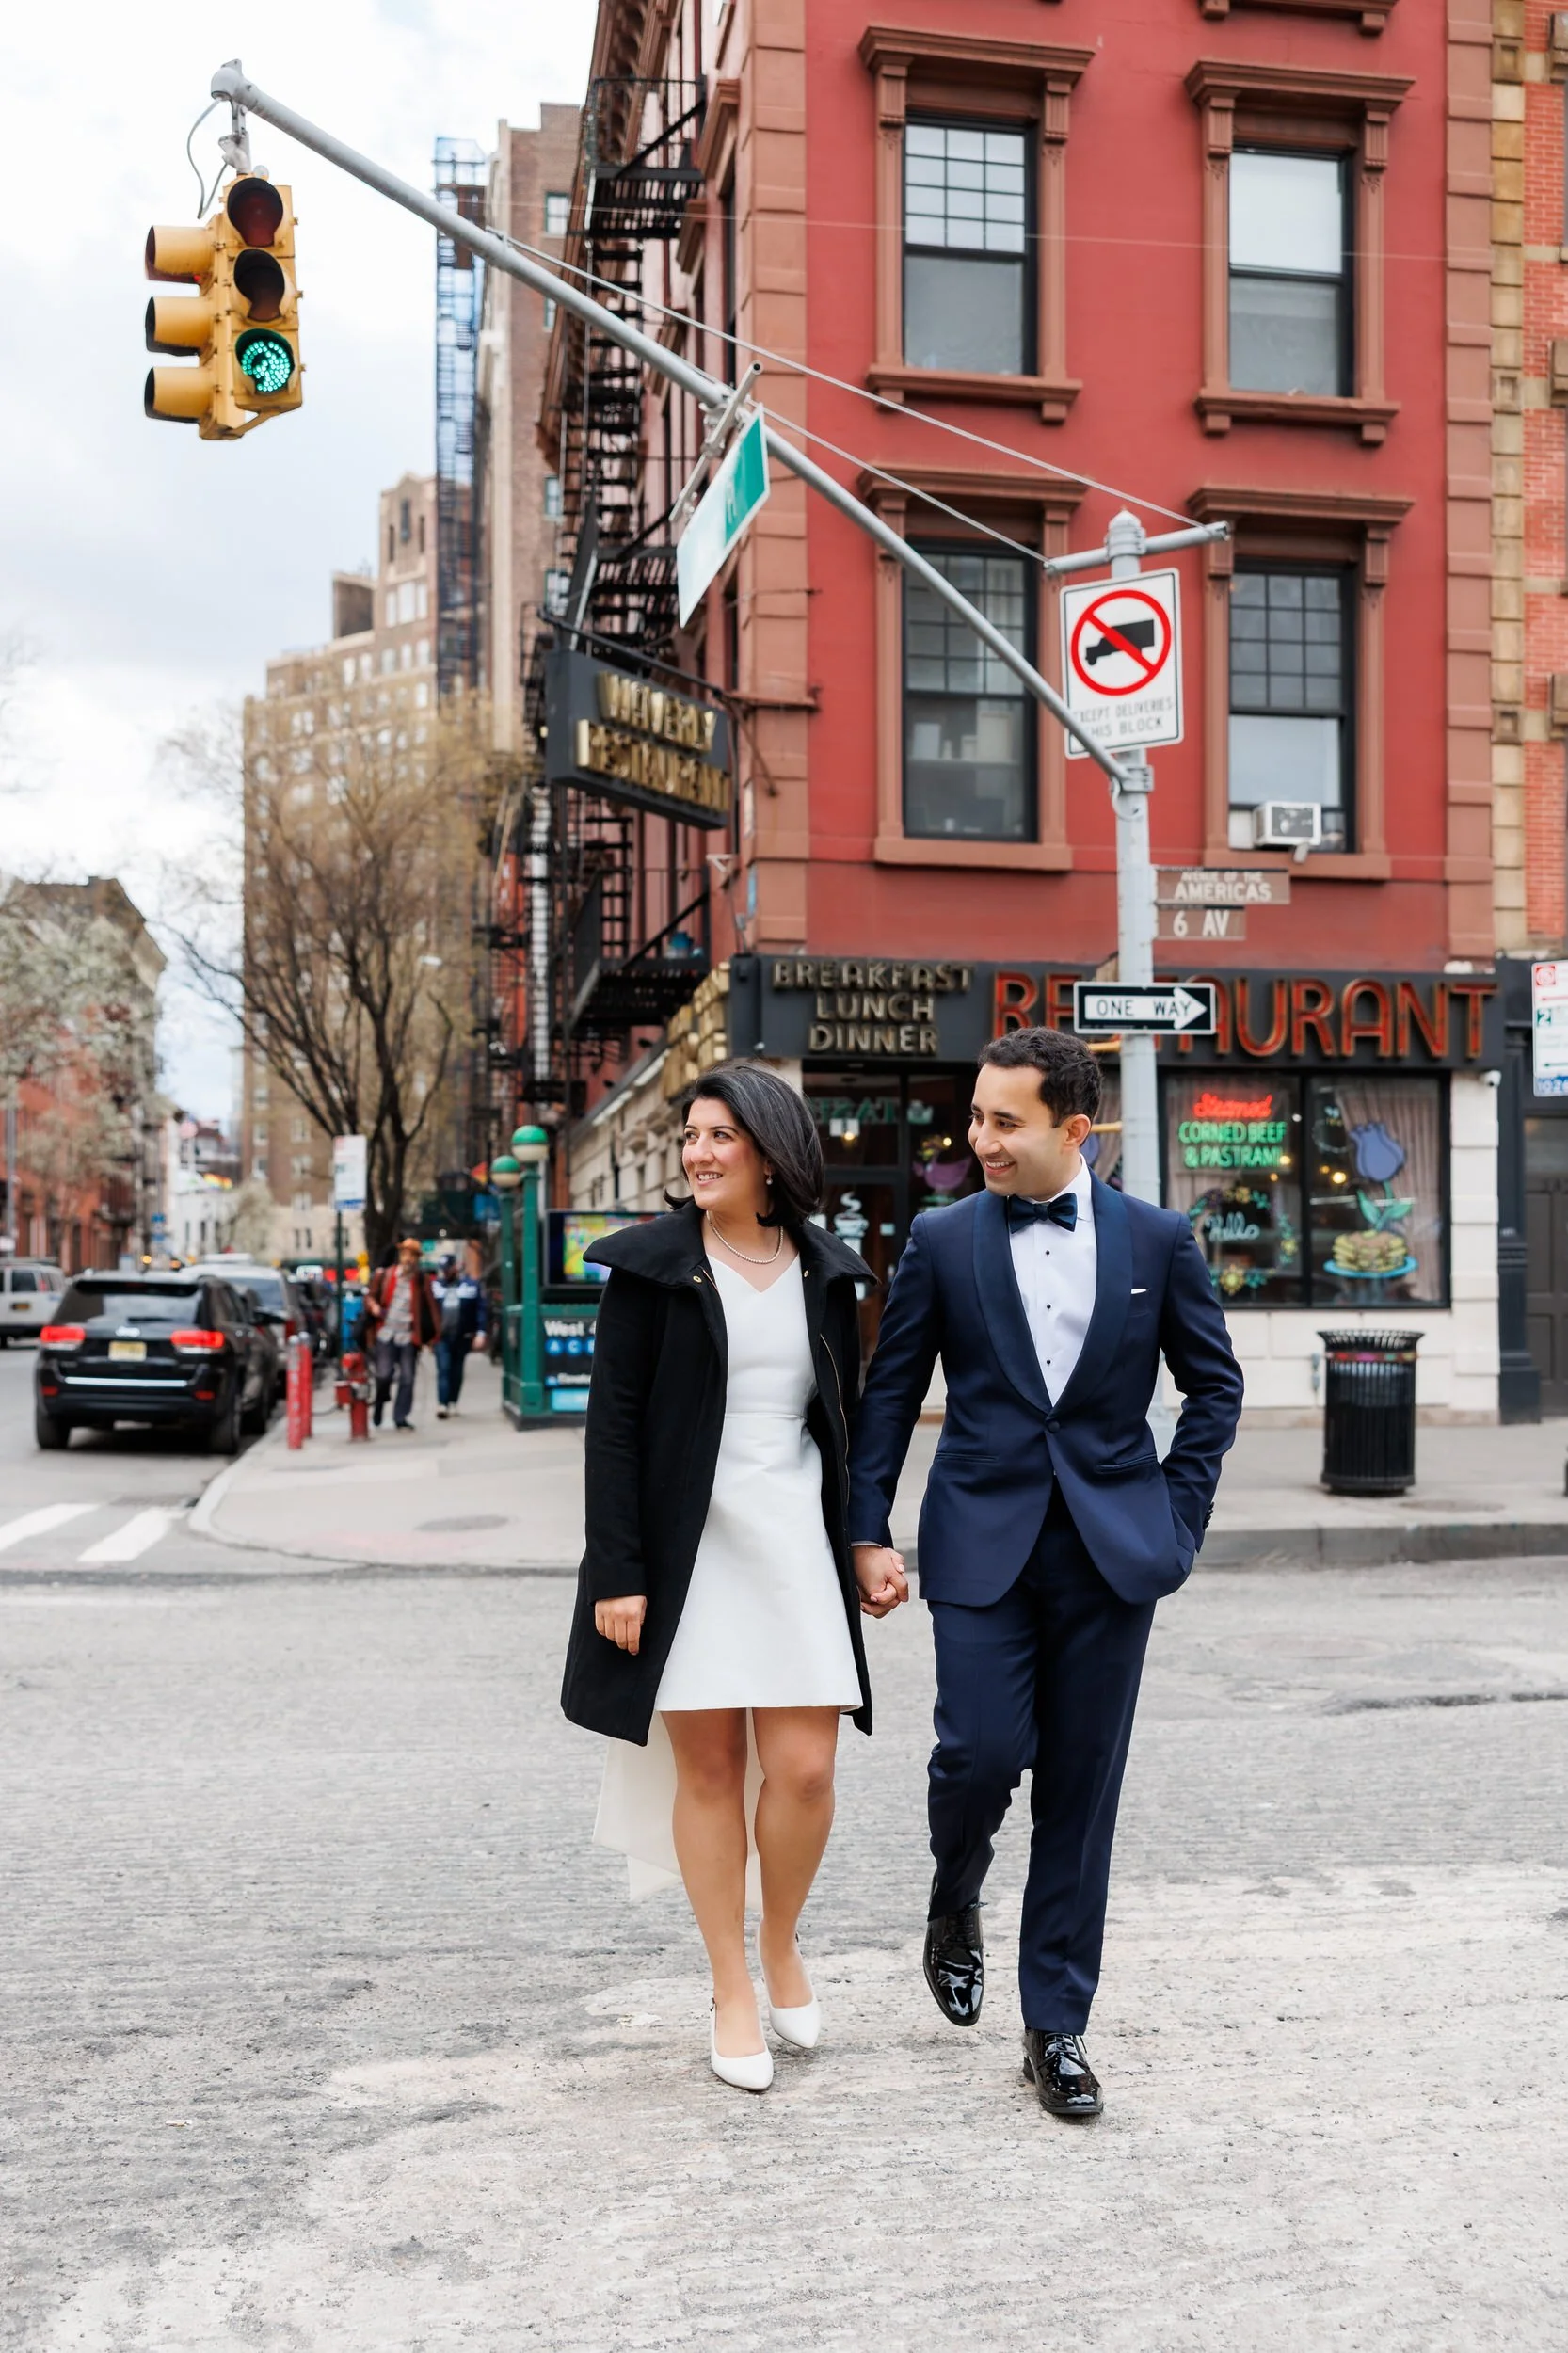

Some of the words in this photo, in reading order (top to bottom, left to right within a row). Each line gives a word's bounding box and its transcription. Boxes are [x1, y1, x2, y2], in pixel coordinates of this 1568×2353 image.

[1119, 717, 1162, 735] BLOCK
[1174, 882, 1272, 902] AMERICAS
[1173, 910, 1188, 937] 6
[1202, 910, 1229, 937] AV
[772, 960, 974, 990] BREAKFAST
[816, 991, 935, 1021] LUNCH
[1096, 1000, 1133, 1016] ONE
[1154, 1001, 1191, 1016] WAY
[808, 1022, 938, 1052] DINNER
[1179, 1121, 1247, 1143] CORNED
[1248, 1121, 1287, 1143] BEEF
[1184, 1145, 1199, 1167] &
[1201, 1145, 1282, 1167] PASTRAMI
[544, 1320, 584, 1337] West
